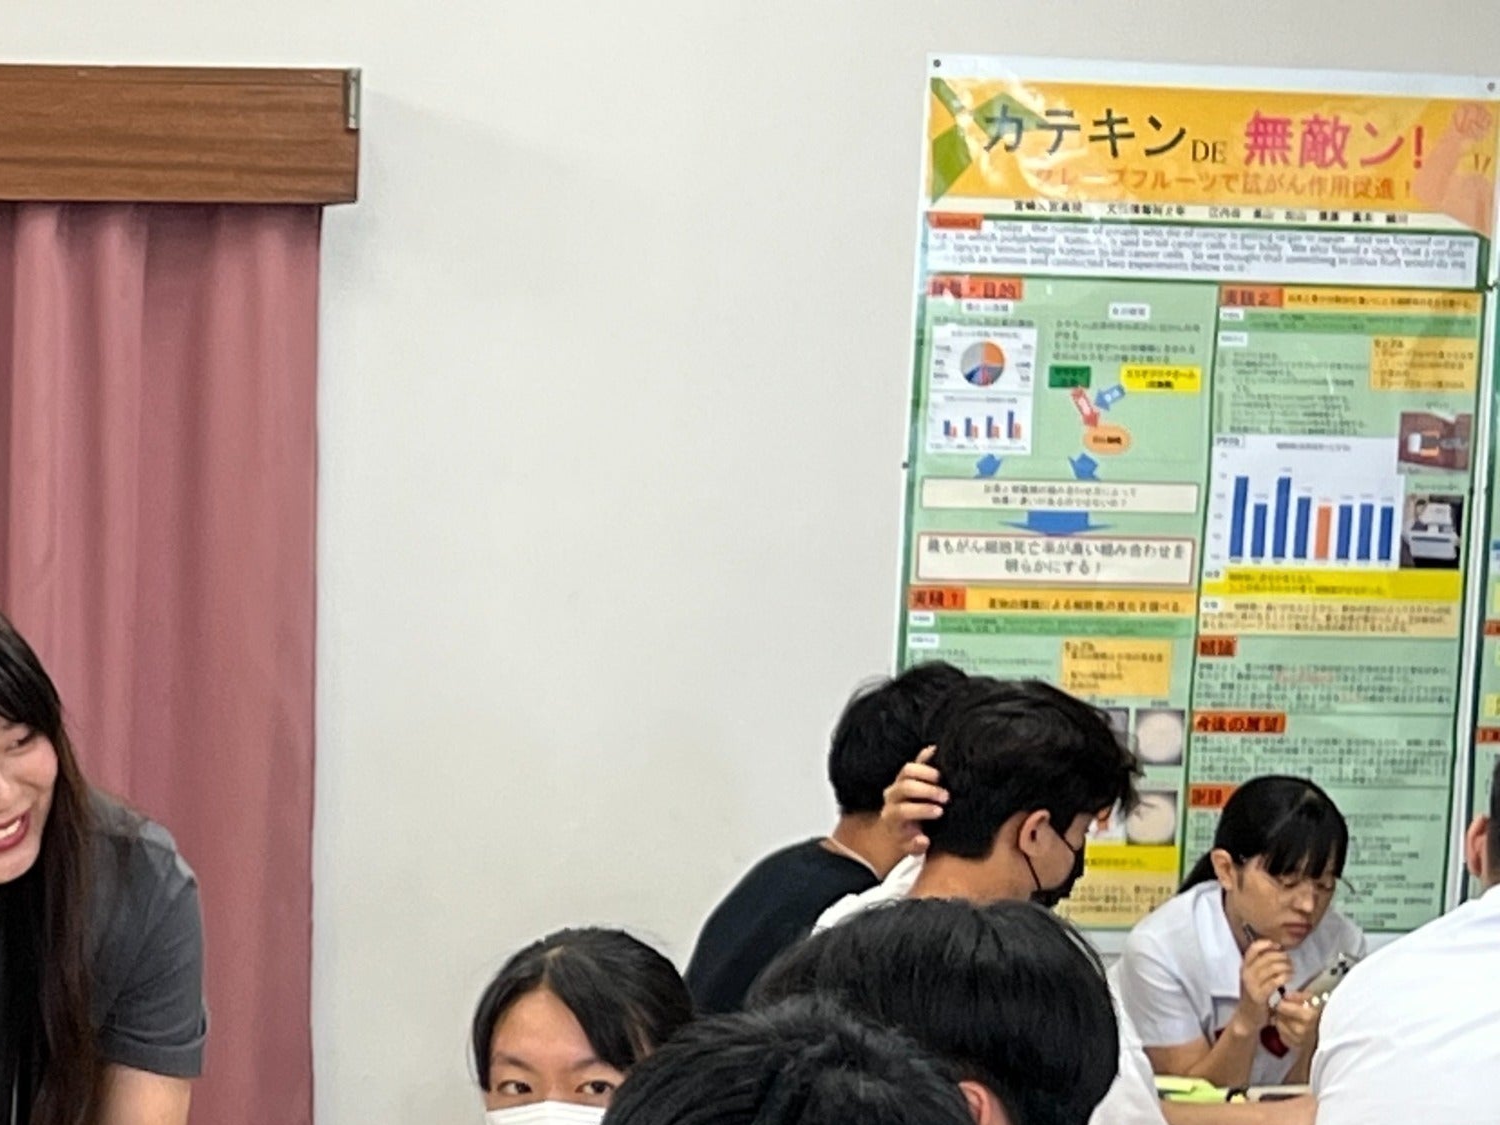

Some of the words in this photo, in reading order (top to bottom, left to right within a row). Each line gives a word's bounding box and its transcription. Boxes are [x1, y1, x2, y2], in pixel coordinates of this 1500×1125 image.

[983, 103, 1187, 158] カテキン
[1191, 138, 1226, 165] DE
[1244, 109, 1423, 170] 無敵ン！
